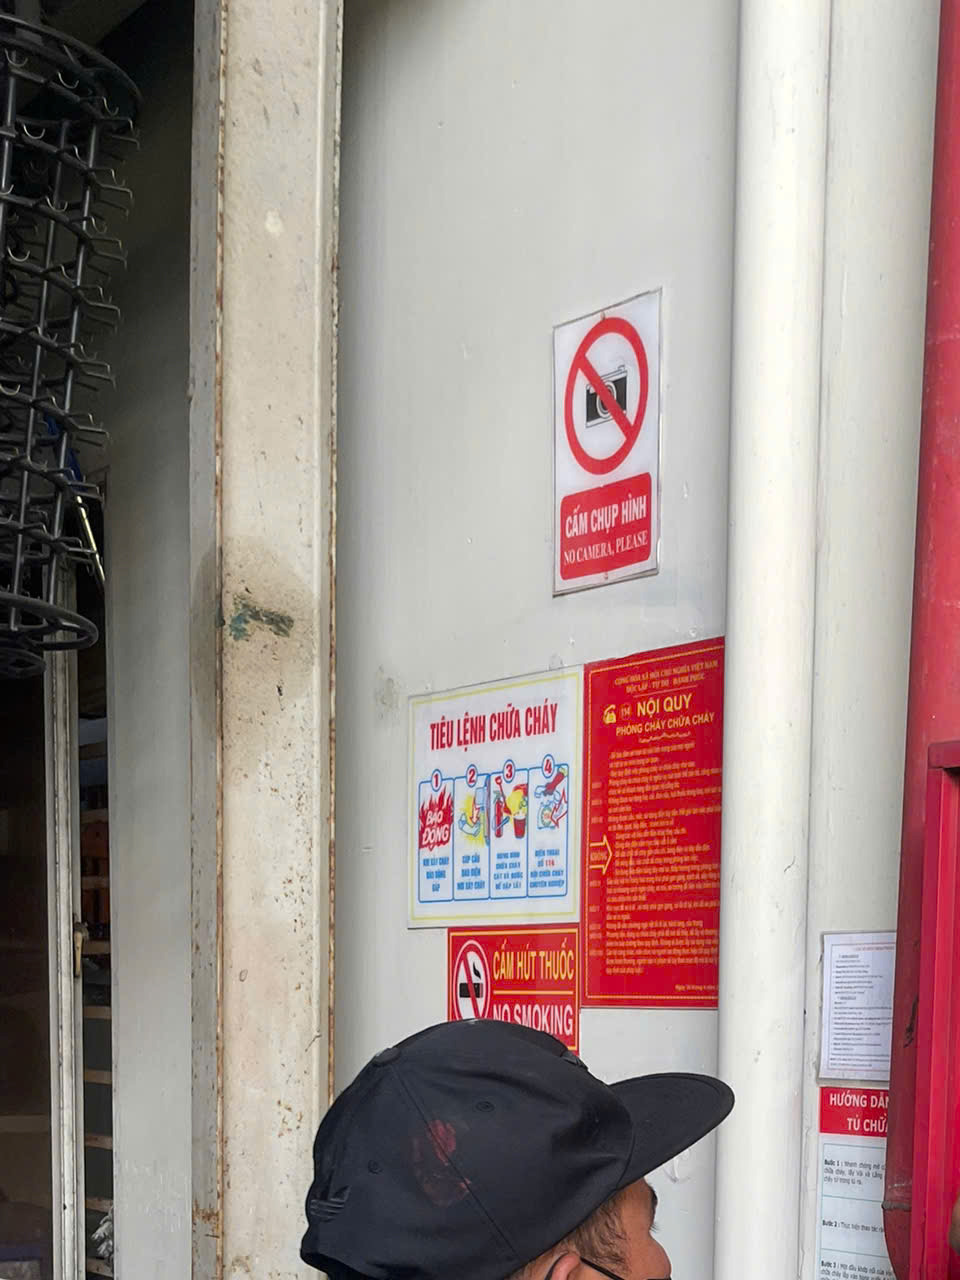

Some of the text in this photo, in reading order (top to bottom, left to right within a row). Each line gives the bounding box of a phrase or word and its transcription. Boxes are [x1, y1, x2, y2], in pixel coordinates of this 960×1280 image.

[565, 493, 647, 539] CẤM CHỤP HÌNH
[563, 529, 648, 566] NO CAMERA, PLEASE
[637, 693, 693, 718] NỘI QUY
[429, 698, 558, 752] TIÊU LỆNH CHỮA CHÁY
[433, 759, 552, 788] 1 2 3 4
[493, 938, 514, 980] CẤM
[516, 943, 537, 980] HÚT
[539, 937, 575, 980] THUỐC
[513, 1004, 574, 1036] SMOKING
[829, 1090, 867, 1108] HƯỚNG
[847, 1113, 888, 1133] TỦ CHỮ
